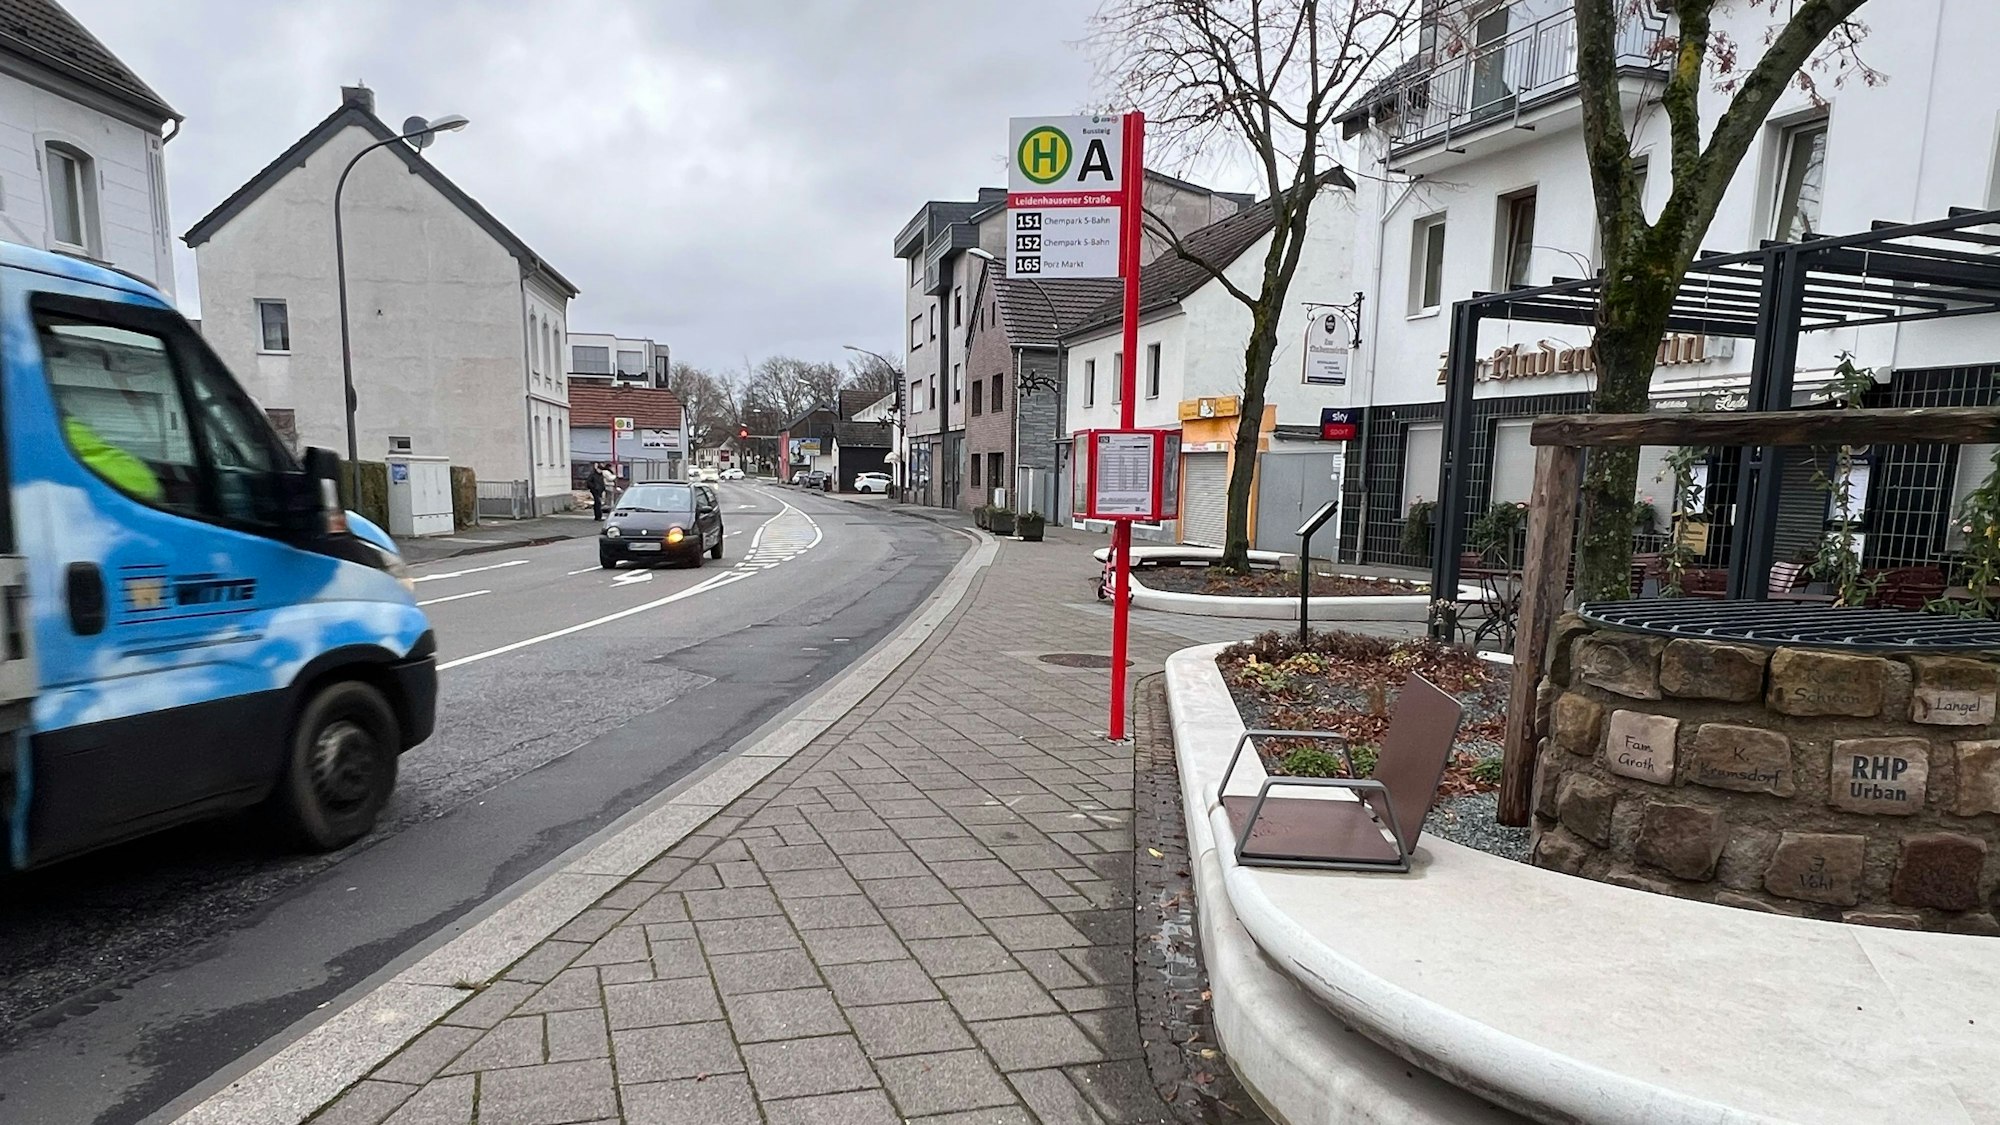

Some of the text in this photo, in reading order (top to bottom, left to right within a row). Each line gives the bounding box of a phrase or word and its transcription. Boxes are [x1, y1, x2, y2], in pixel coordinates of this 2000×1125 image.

[1032, 137, 1114, 182] H A
[1015, 194, 1111, 206] Leidenhausener Straße
[1017, 215, 1110, 228] 151 Chempark S-Bahn
[1017, 237, 1110, 249] 152 Chempark S-Bahn
[1016, 259, 1084, 271] 165 Porz Markt
[1332, 411, 1348, 423] sky
[1625, 734, 1654, 753] Fam.
[1733, 746, 1750, 762] K.
[1618, 752, 1655, 773] Groth
[1852, 755, 1908, 781] RHP
[1850, 782, 1908, 801] Urban
